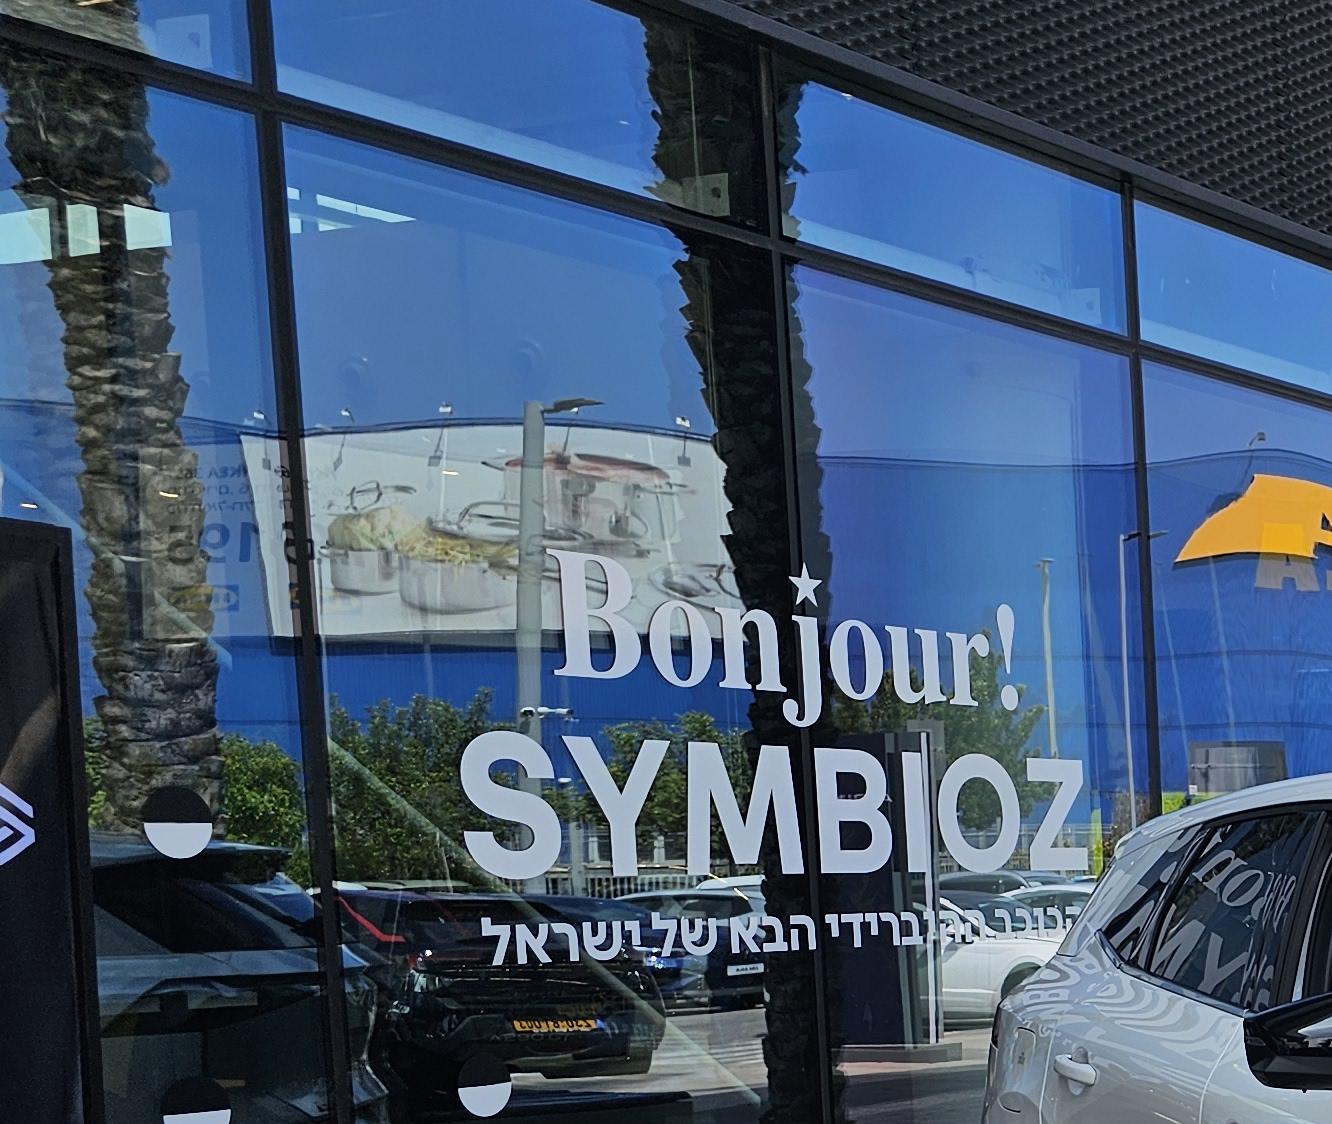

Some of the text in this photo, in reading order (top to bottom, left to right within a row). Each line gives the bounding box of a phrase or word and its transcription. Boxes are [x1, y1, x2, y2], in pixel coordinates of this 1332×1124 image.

[545, 548, 1020, 728] Bonjour!
[459, 730, 1090, 880] SYMBIOZ
[480, 916, 642, 966] ישראל
[651, 911, 717, 957] של
[729, 914, 817, 954] הבא
